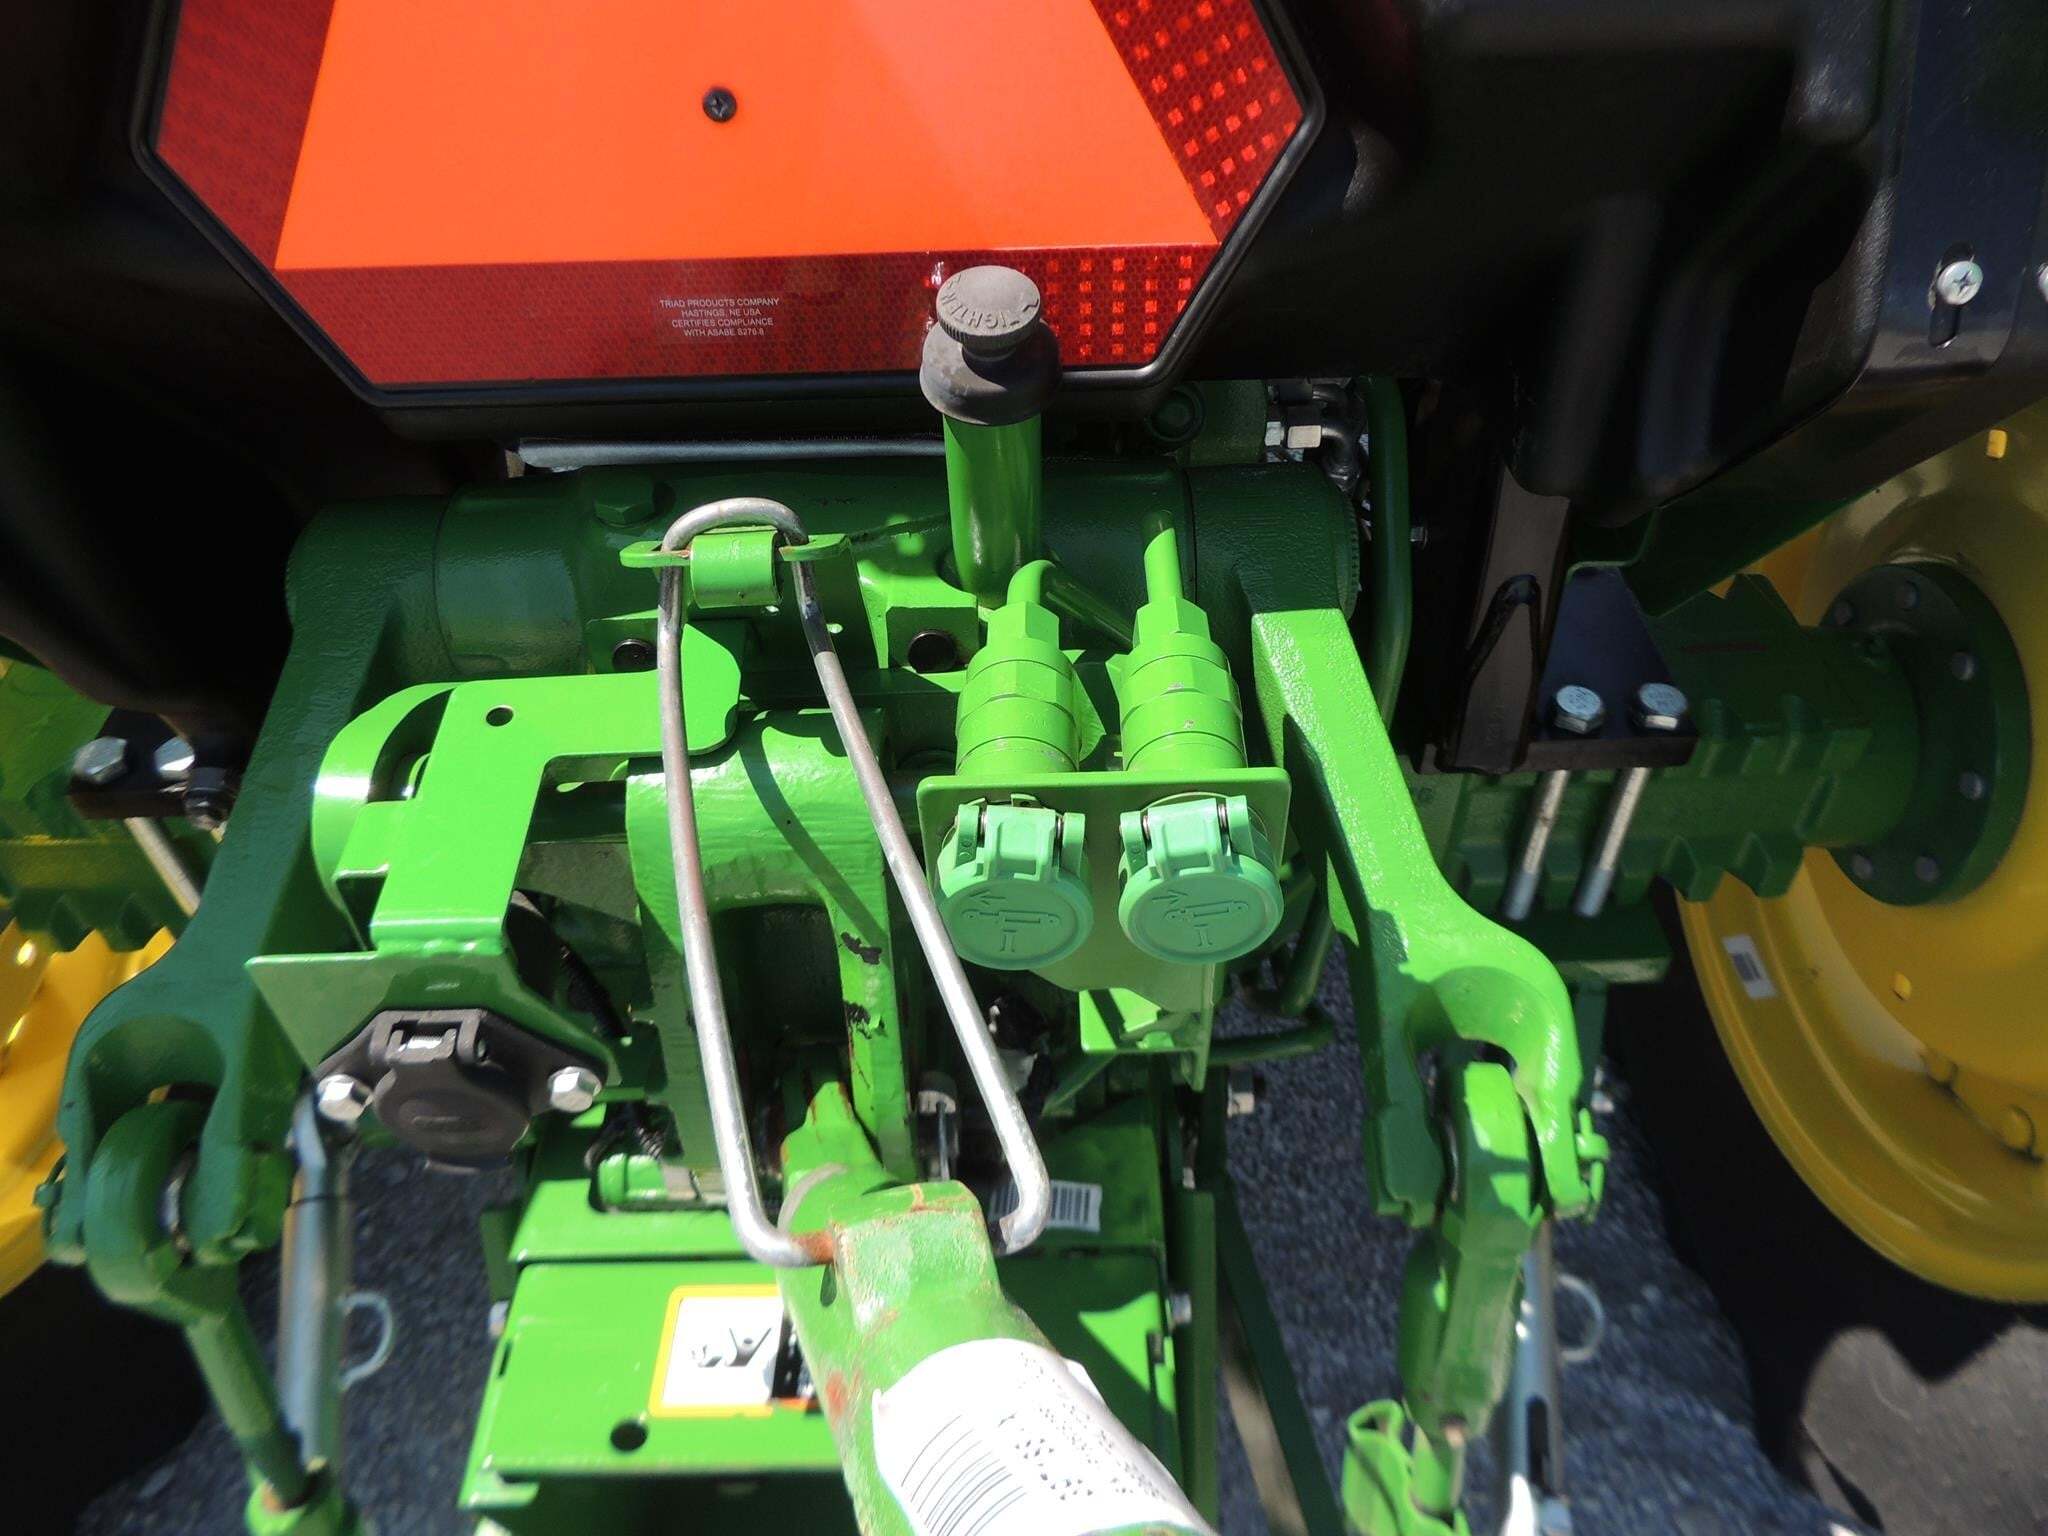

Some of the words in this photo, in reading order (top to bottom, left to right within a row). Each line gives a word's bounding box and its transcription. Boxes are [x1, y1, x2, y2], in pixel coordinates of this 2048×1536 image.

[660, 299, 686, 309] TRIAD
[687, 298, 735, 308] PRODUCTS
[737, 297, 779, 307] COMPANY
[729, 308, 741, 317] NE
[743, 307, 762, 316] USA
[672, 318, 716, 328] CERTIFIES
[718, 317, 774, 327] COMPLIANCE
[684, 328, 706, 337] WITH
[707, 328, 735, 337] ASABE
